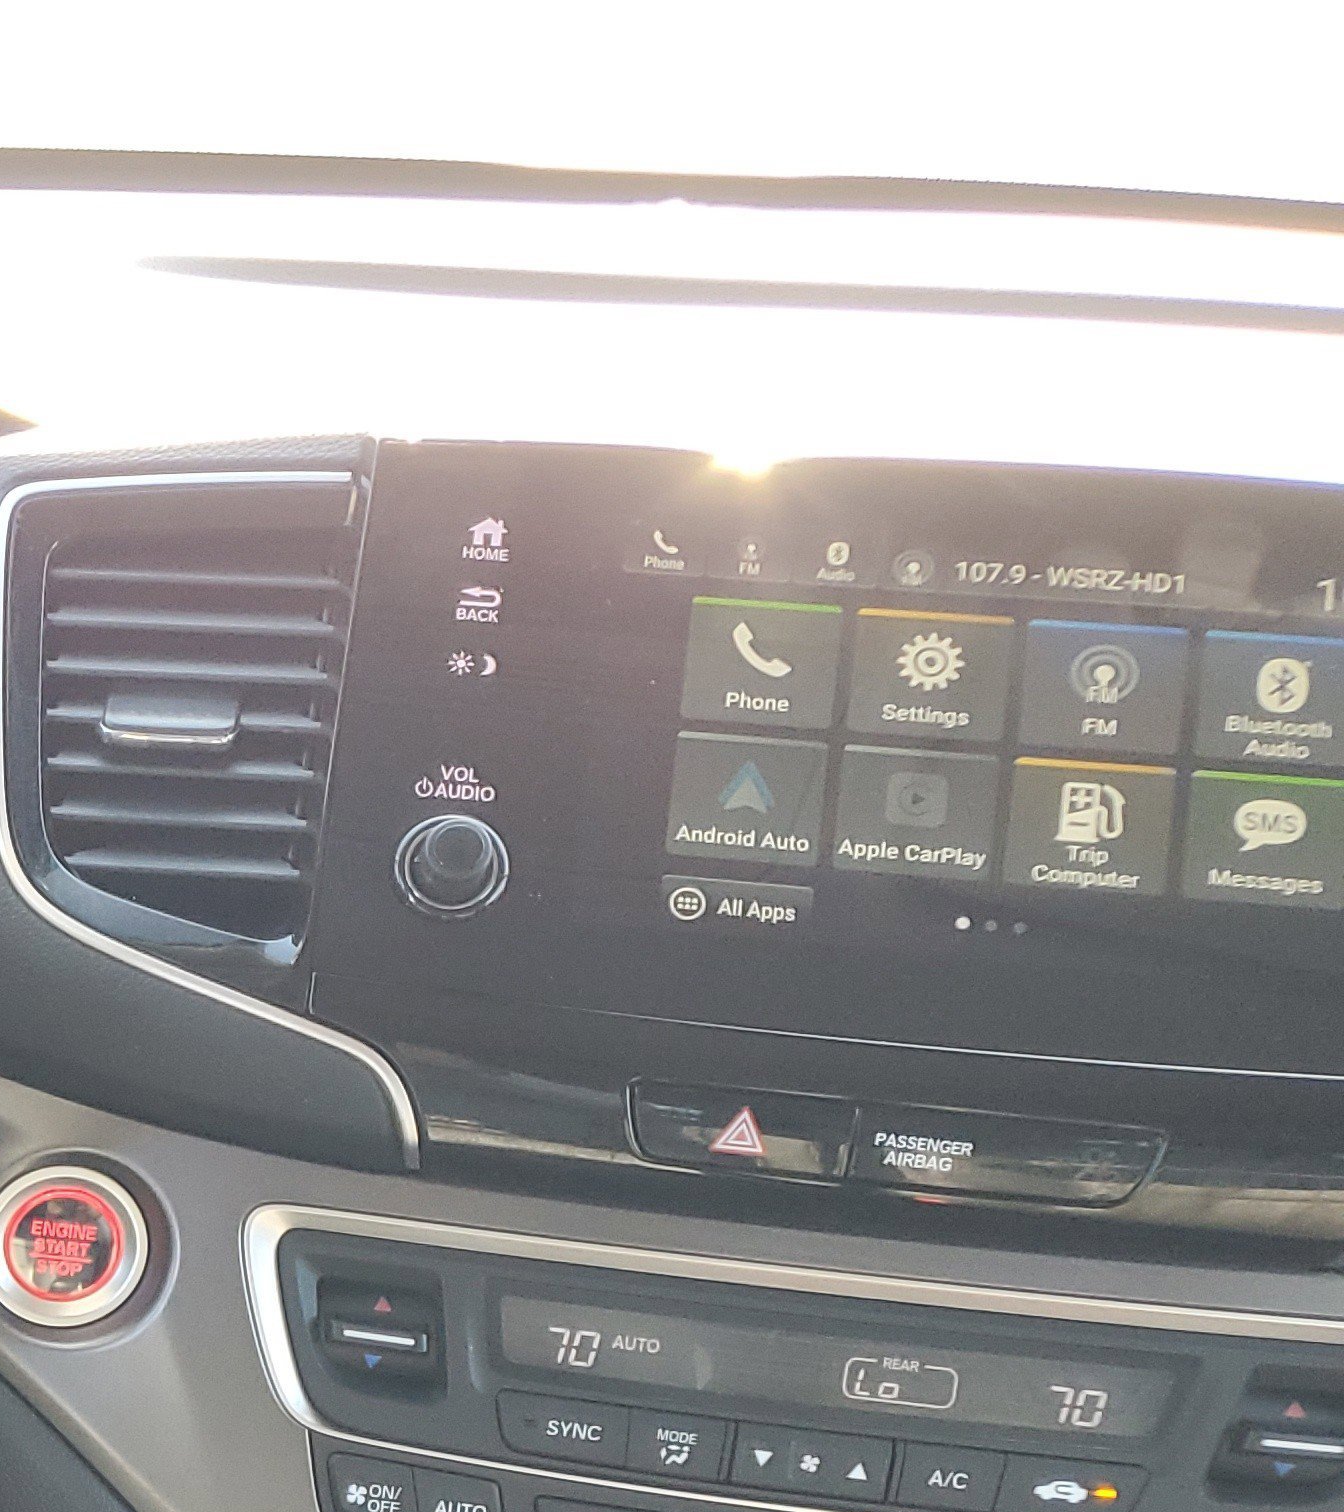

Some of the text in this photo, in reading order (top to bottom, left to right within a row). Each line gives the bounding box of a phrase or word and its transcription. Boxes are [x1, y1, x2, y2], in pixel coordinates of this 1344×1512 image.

[462, 546, 510, 563] HOME
[643, 555, 686, 572] Phone
[738, 561, 761, 576] FM
[815, 566, 856, 583] Audio
[954, 561, 1028, 585] 107.9
[1047, 566, 1186, 594] WSRZ-HD1
[456, 607, 500, 624] BACK
[724, 691, 790, 713] Phone
[881, 704, 971, 728] Settings
[1081, 718, 1118, 736] FM
[1224, 715, 1333, 739] Bluetooth
[1243, 740, 1311, 759] Audio
[441, 764, 480, 784] VOL
[434, 783, 496, 802] AUDIO
[1243, 811, 1300, 835] SMS
[674, 825, 810, 853] Android Auto
[838, 838, 987, 870] Apple CarPlay
[1066, 845, 1110, 867] Trip
[1031, 865, 1141, 890] Computer
[1208, 869, 1325, 895] Messages
[716, 898, 797, 924] All Apps
[874, 1131, 974, 1158] PASSENGER
[883, 1150, 954, 1172] AIRBAG
[30, 1219, 99, 1242] ENGINE
[32, 1237, 91, 1258] START
[35, 1260, 83, 1277] STOP
[548, 1326, 661, 1368] 70 AUTO
[883, 1357, 920, 1373] REAR
[1050, 1386, 1109, 1429] 70
[546, 1420, 603, 1442] SYNC
[656, 1428, 699, 1446] MODE
[928, 1469, 970, 1490] A/C
[368, 1484, 403, 1502] ON/
